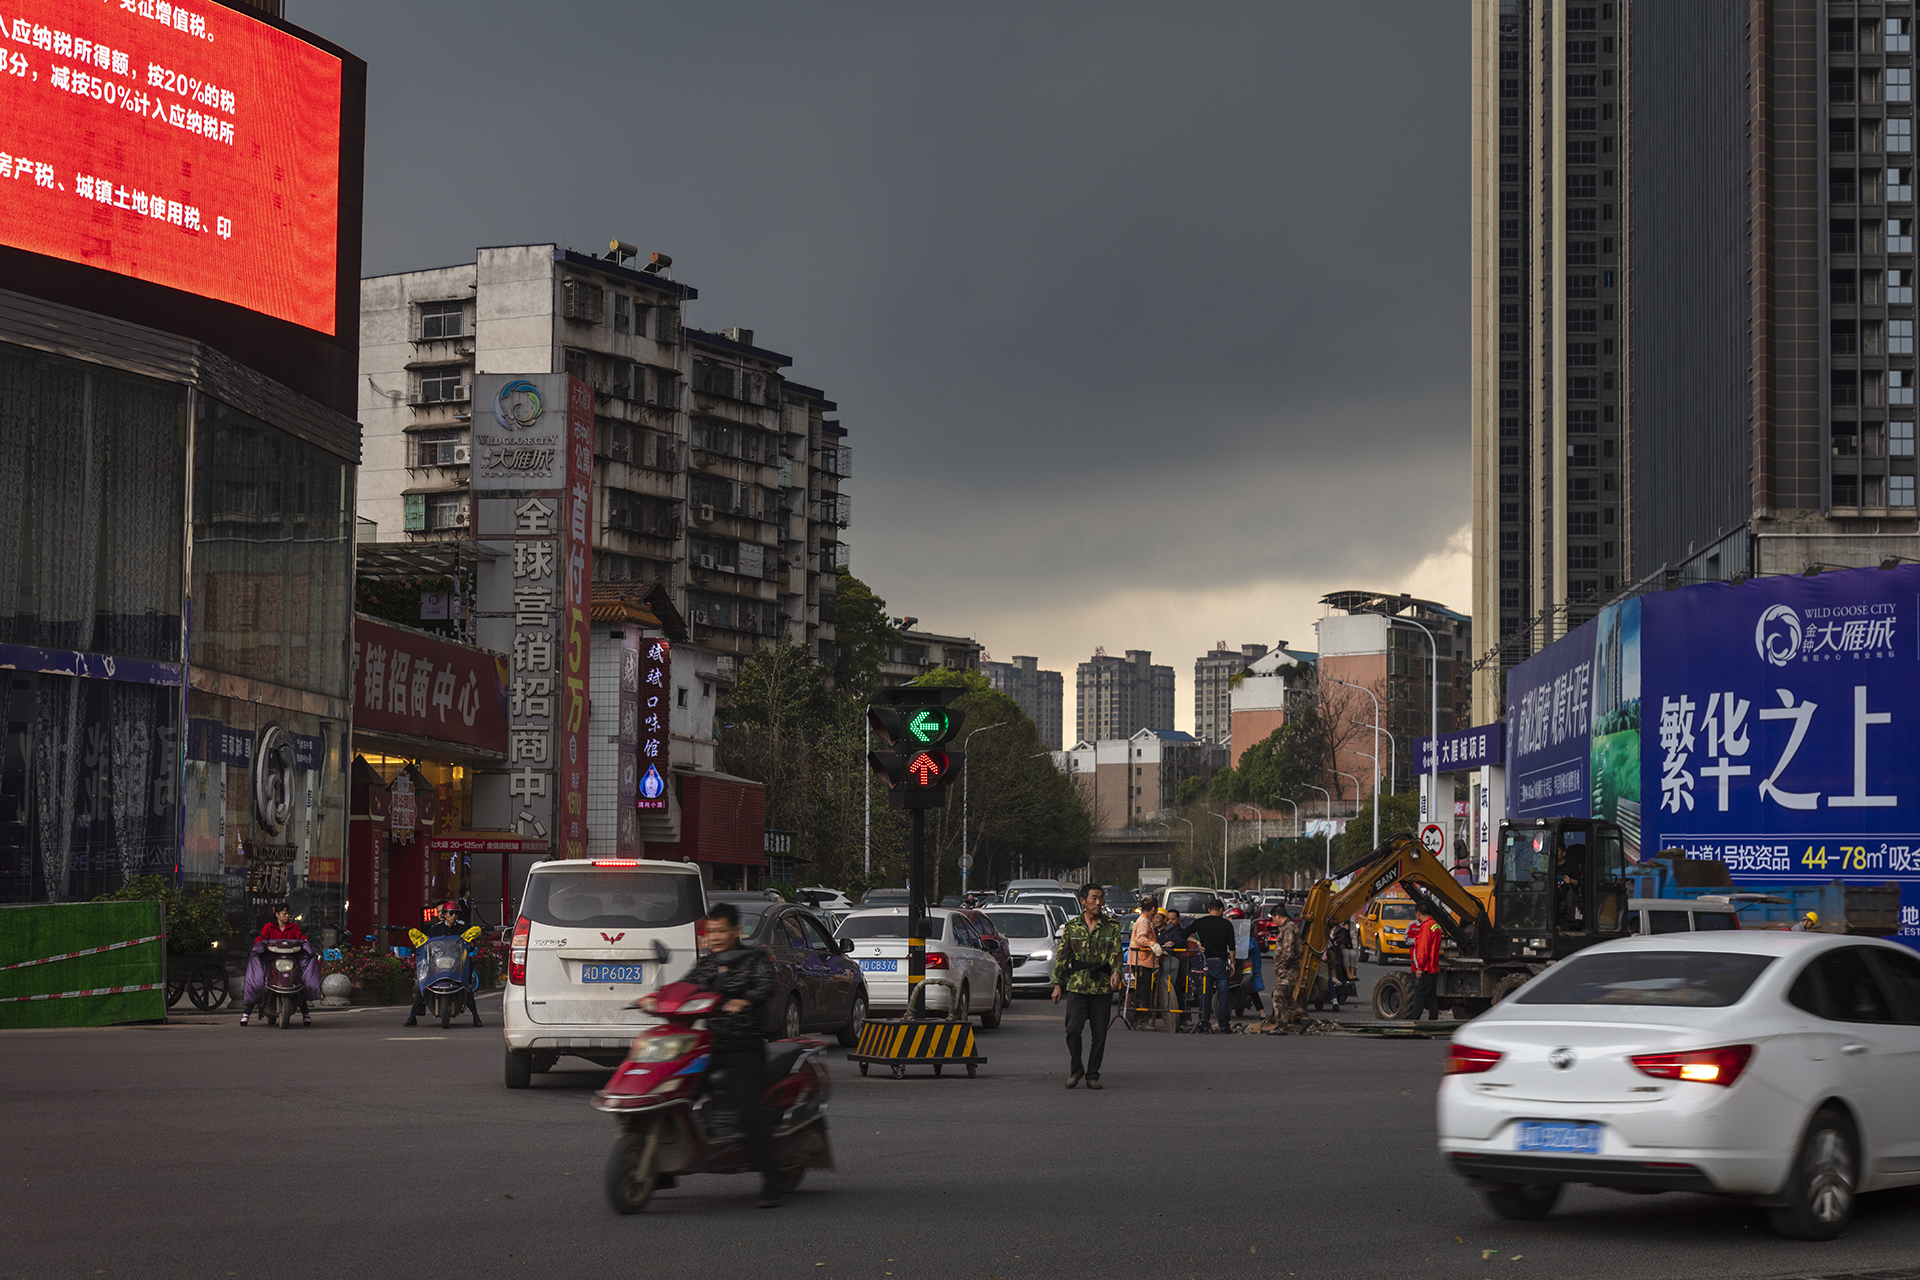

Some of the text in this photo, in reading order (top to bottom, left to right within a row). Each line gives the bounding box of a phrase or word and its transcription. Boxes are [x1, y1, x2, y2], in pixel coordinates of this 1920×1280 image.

[475, 434, 558, 445] WILD GOOSE CITY
[489, 448, 555, 470] 大雁城
[1804, 603, 1897, 619] WILD GOOSE CITY
[1813, 617, 1897, 653] 大雁城
[510, 498, 554, 838] 全球营销招商中心
[1659, 685, 1898, 814] 繁华之上
[1425, 835, 1440, 847] 3.4m
[1666, 844, 1791, 872] 大道1号投资品
[1374, 866, 1398, 891] SANY
